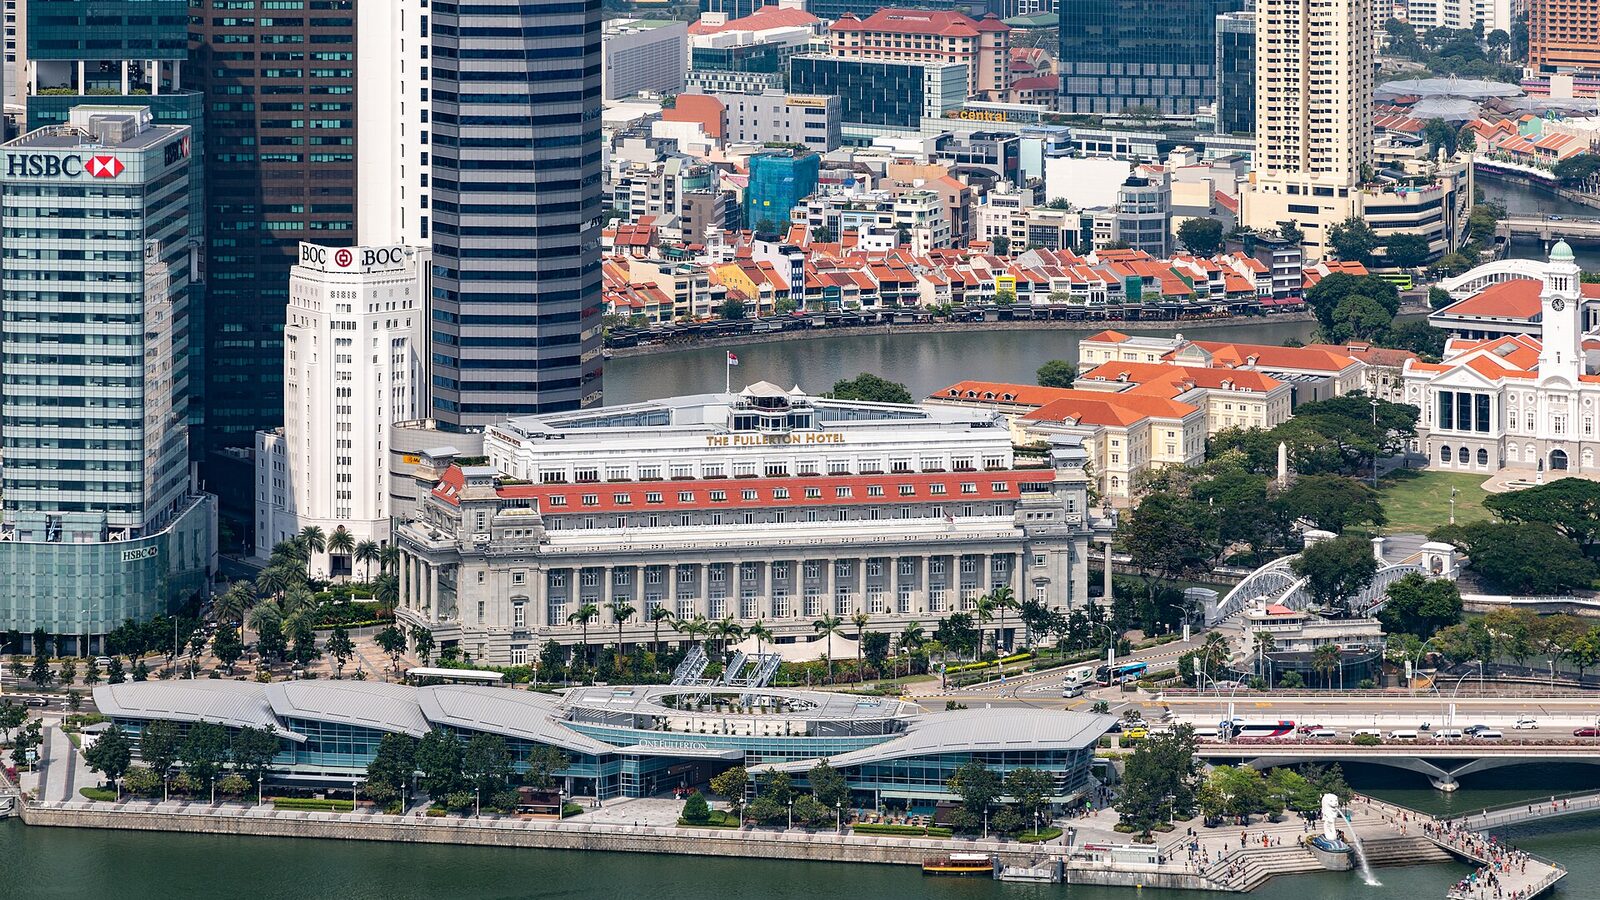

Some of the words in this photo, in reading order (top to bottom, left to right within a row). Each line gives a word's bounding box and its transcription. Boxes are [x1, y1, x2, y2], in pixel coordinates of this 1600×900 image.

[960, 110, 1007, 122] central
[6, 154, 82, 176] HSBC
[302, 245, 326, 264] BOC
[363, 247, 403, 266] BOC
[706, 436, 730, 446] THE
[733, 434, 802, 446] FULLERTON
[806, 433, 846, 443] HOTEL
[123, 549, 148, 560] HSBC
